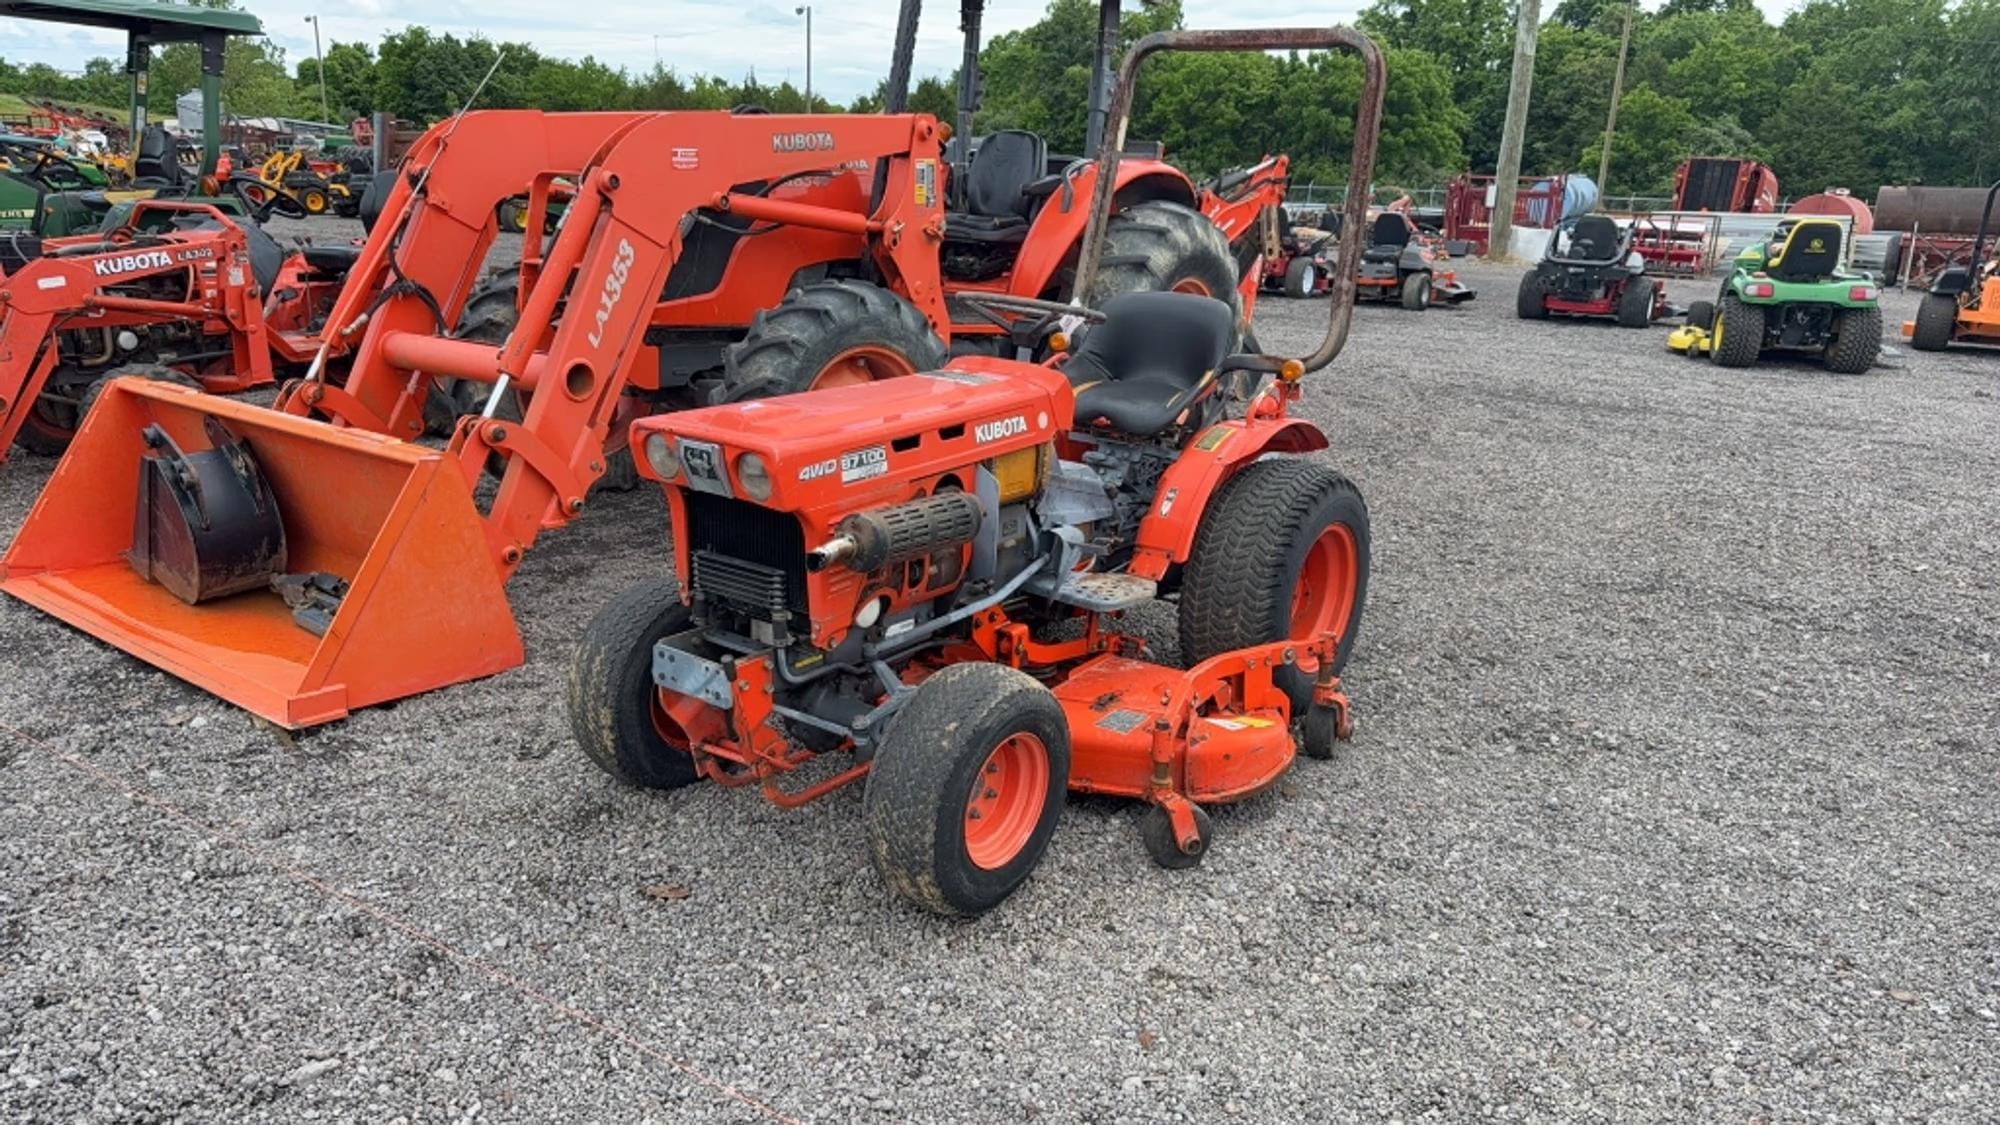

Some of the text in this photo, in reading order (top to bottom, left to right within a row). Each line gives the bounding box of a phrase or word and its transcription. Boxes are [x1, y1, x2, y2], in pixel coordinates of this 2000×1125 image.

[772, 133, 834, 151] KUBOTA
[94, 251, 173, 276] KUBOTA
[177, 248, 213, 261] LA302
[588, 238, 634, 349] LA1353
[974, 416, 1028, 443] KUBOTA
[798, 459, 837, 480] 4WD
